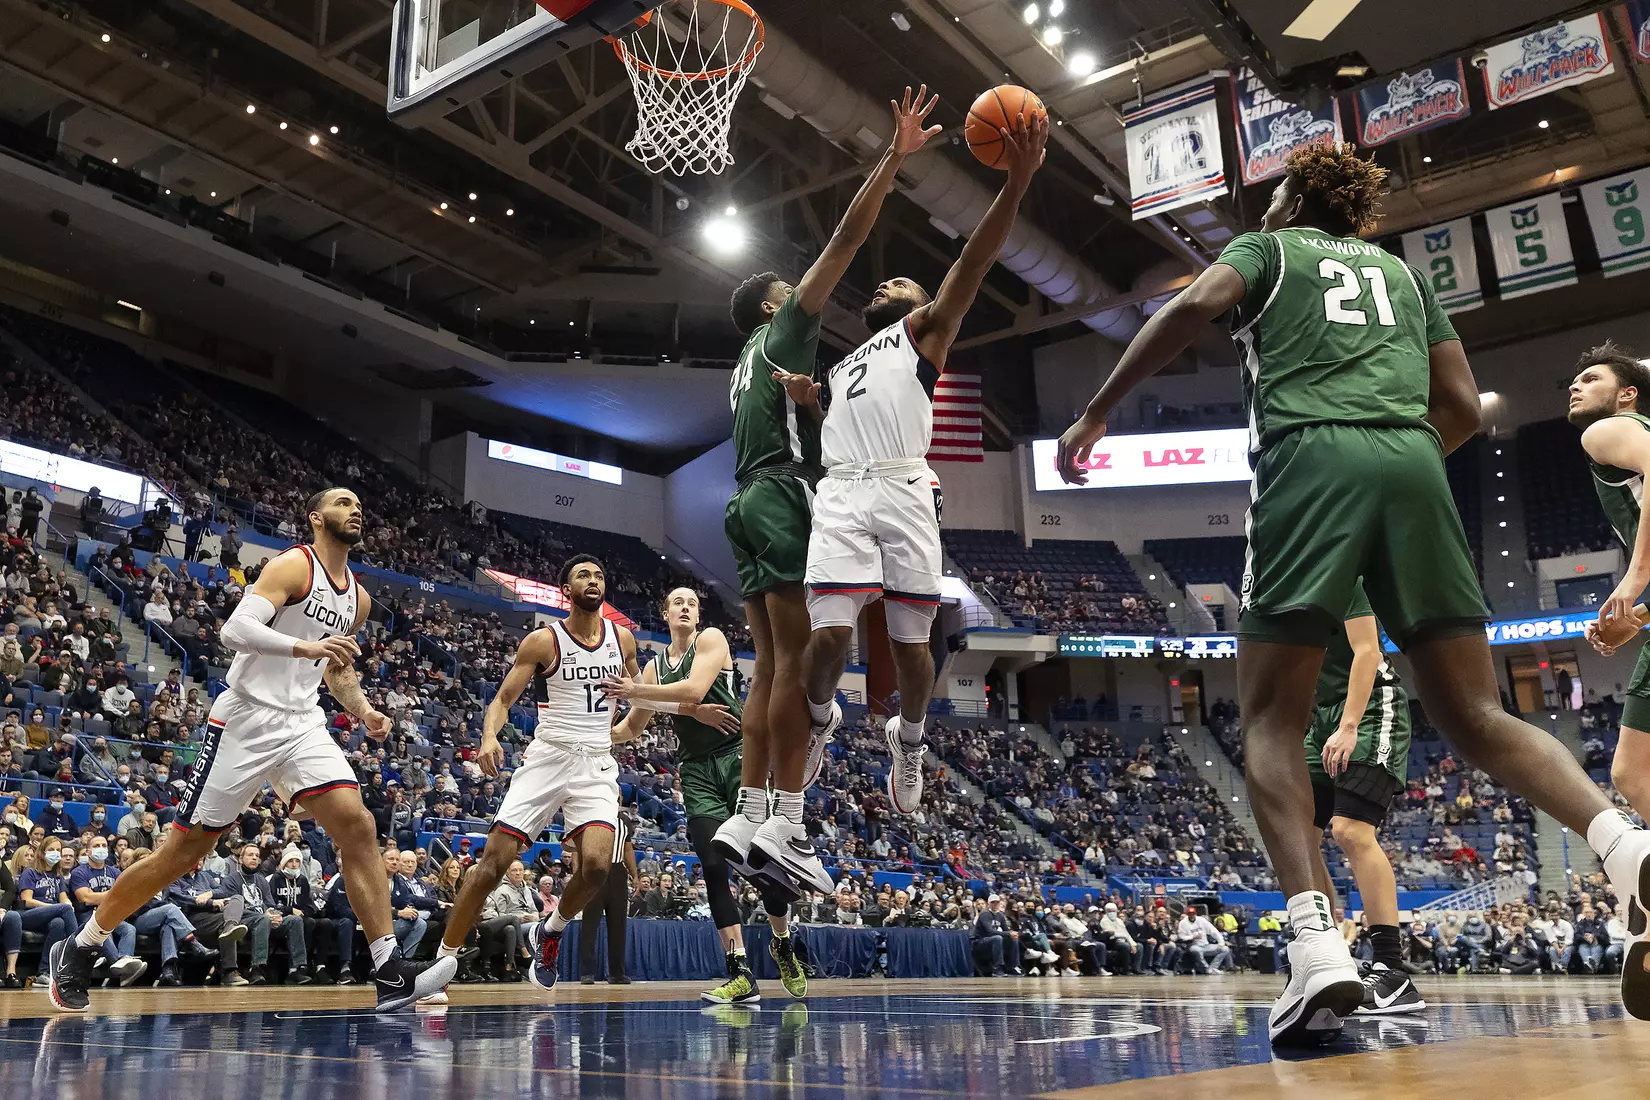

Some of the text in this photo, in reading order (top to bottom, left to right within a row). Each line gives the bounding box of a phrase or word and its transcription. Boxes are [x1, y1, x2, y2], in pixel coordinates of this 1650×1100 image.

[1548, 47, 1600, 79] PACK
[1412, 92, 1458, 122] PACK
[1614, 205, 1645, 246] 9
[1515, 230, 1548, 267] 5
[1430, 255, 1457, 292] 2
[1318, 257, 1397, 326] 21
[831, 334, 900, 379] UCONN
[847, 363, 867, 400] 2
[1143, 447, 1205, 467] LAZ
[555, 494, 574, 507] 207
[1040, 514, 1061, 526] 232
[1207, 514, 1229, 525] 233
[419, 580, 435, 592] 105
[303, 600, 353, 634] UCONN
[1502, 619, 1564, 640] HOPS
[562, 664, 621, 681] UCONN
[957, 679, 973, 687] 107
[583, 684, 609, 713] 12
[179, 731, 216, 814] HUSKIES
